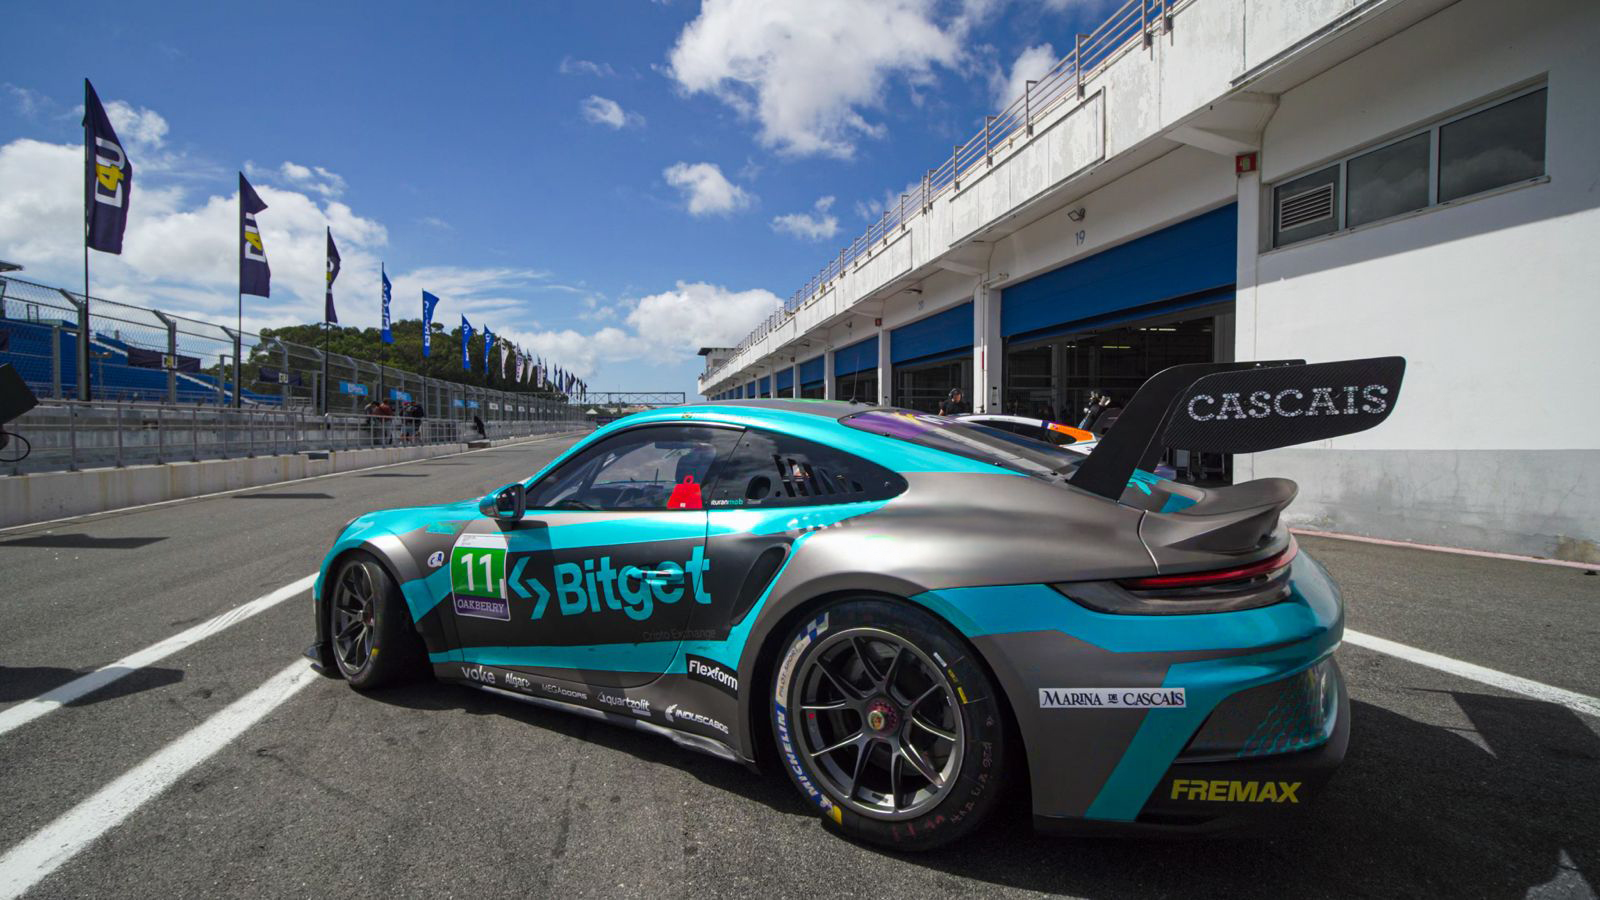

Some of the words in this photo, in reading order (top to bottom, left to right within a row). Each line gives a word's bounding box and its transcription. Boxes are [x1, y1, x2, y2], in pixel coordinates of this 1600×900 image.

[95, 136, 125, 208] L4U
[1075, 229, 1086, 247] 19
[1187, 384, 1389, 422] CASCAIS
[460, 553, 493, 593] 11
[553, 546, 712, 621] Bitget
[457, 599, 505, 613] OAKBERRY
[461, 665, 496, 684] voke
[688, 660, 738, 691] Flexform
[605, 695, 650, 712] quartzolit
[1042, 690, 1104, 706] MARINA
[1122, 691, 1185, 706] CASCAIS
[776, 710, 819, 797] MICHELIN
[1170, 779, 1302, 803] FREMAX
